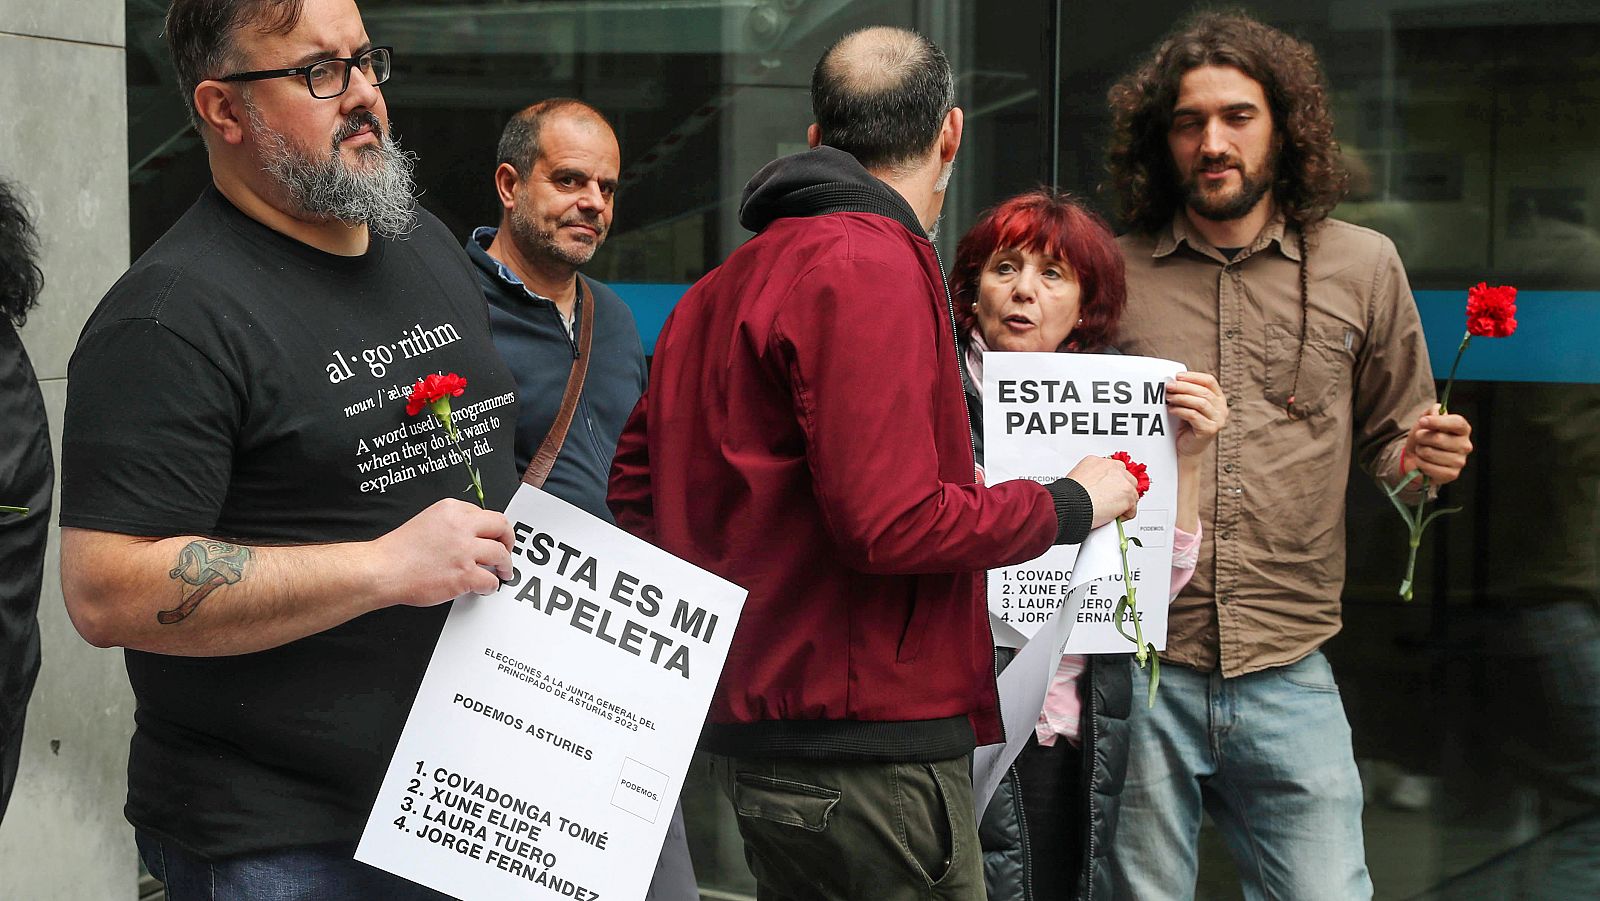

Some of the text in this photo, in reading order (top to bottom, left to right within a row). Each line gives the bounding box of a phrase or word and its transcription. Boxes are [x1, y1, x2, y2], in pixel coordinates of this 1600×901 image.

[343, 397, 376, 418] noun
[998, 380, 1167, 405] ESTA ES M
[356, 439, 371, 456] A
[372, 423, 409, 449] word
[409, 414, 436, 436] used
[450, 391, 515, 424] programmers
[357, 450, 401, 474] when
[402, 440, 428, 459] they
[431, 434, 445, 449] do
[463, 420, 489, 439] want
[490, 416, 500, 429] to
[1006, 412, 1165, 436] PAPELETA
[359, 464, 417, 493] explain
[417, 454, 450, 475] what
[473, 438, 494, 457] did.
[511, 521, 719, 644] ESTA ES MI
[1002, 570, 1012, 581] 1.
[1002, 584, 1014, 595] 2.
[1019, 584, 1056, 595] XUNE
[1002, 598, 1014, 609] 3.
[1001, 612, 1014, 623] 4.
[1077, 608, 1143, 623] ERNÁDEZ
[484, 648, 542, 679] ELECCIONES
[552, 677, 563, 689] LA
[565, 684, 594, 702] JUNTA
[596, 698, 637, 722] GENERAL
[639, 717, 656, 731] DEL
[497, 663, 639, 732] PRINCIPADO DE ASTURIAS 2023
[453, 693, 593, 761] PODEMOS ASTURIES
[407, 778, 542, 842] 2. XUNE ELIPE
[415, 760, 609, 851] 1. COVADONGA TOMÉ
[620, 779, 659, 802] PODEMOS.
[393, 815, 600, 901] 4. JORGE FERNÁNDEZ
[400, 796, 557, 868] 3. LAURA TUERO
